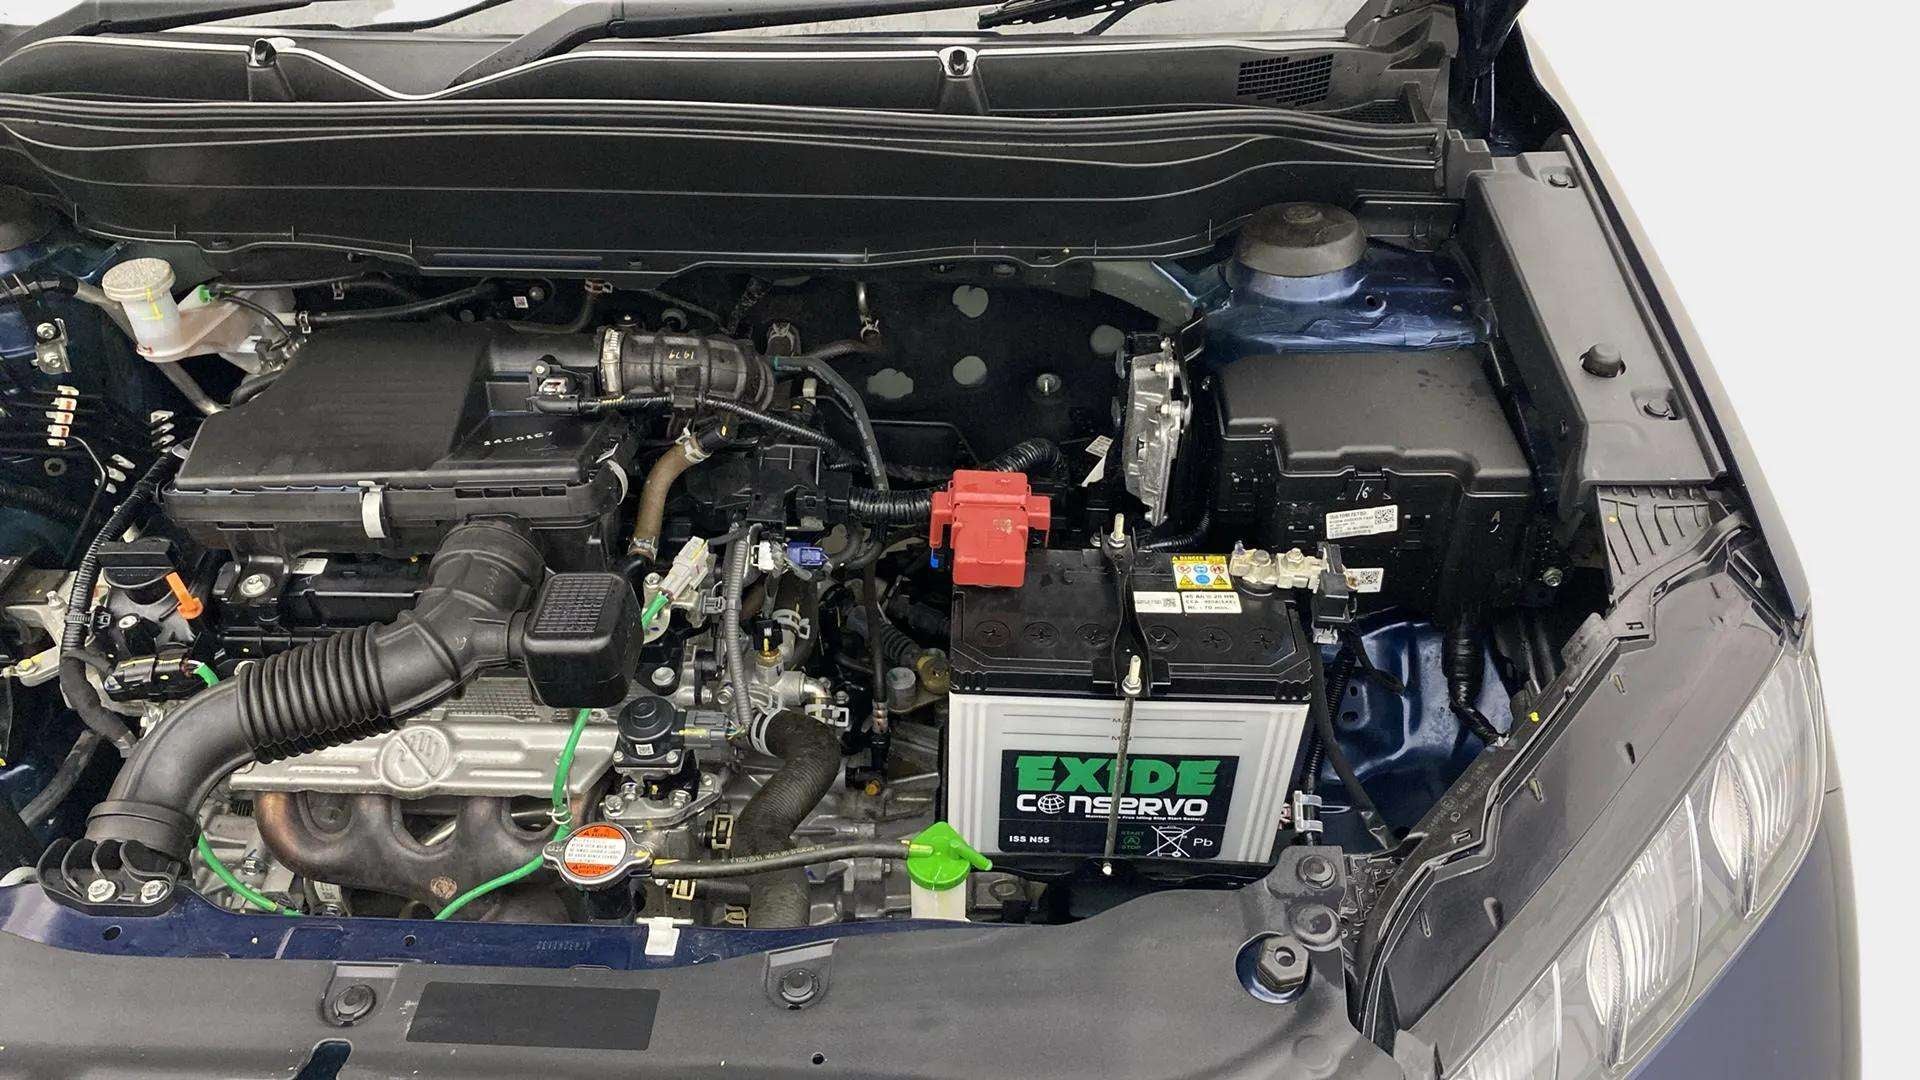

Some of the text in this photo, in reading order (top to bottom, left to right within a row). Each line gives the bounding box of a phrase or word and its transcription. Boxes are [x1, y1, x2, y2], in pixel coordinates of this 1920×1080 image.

[1015, 756, 1221, 796] EXIDE
[1009, 835, 1050, 844] ISS N55
[1193, 838, 1213, 847] Pb
